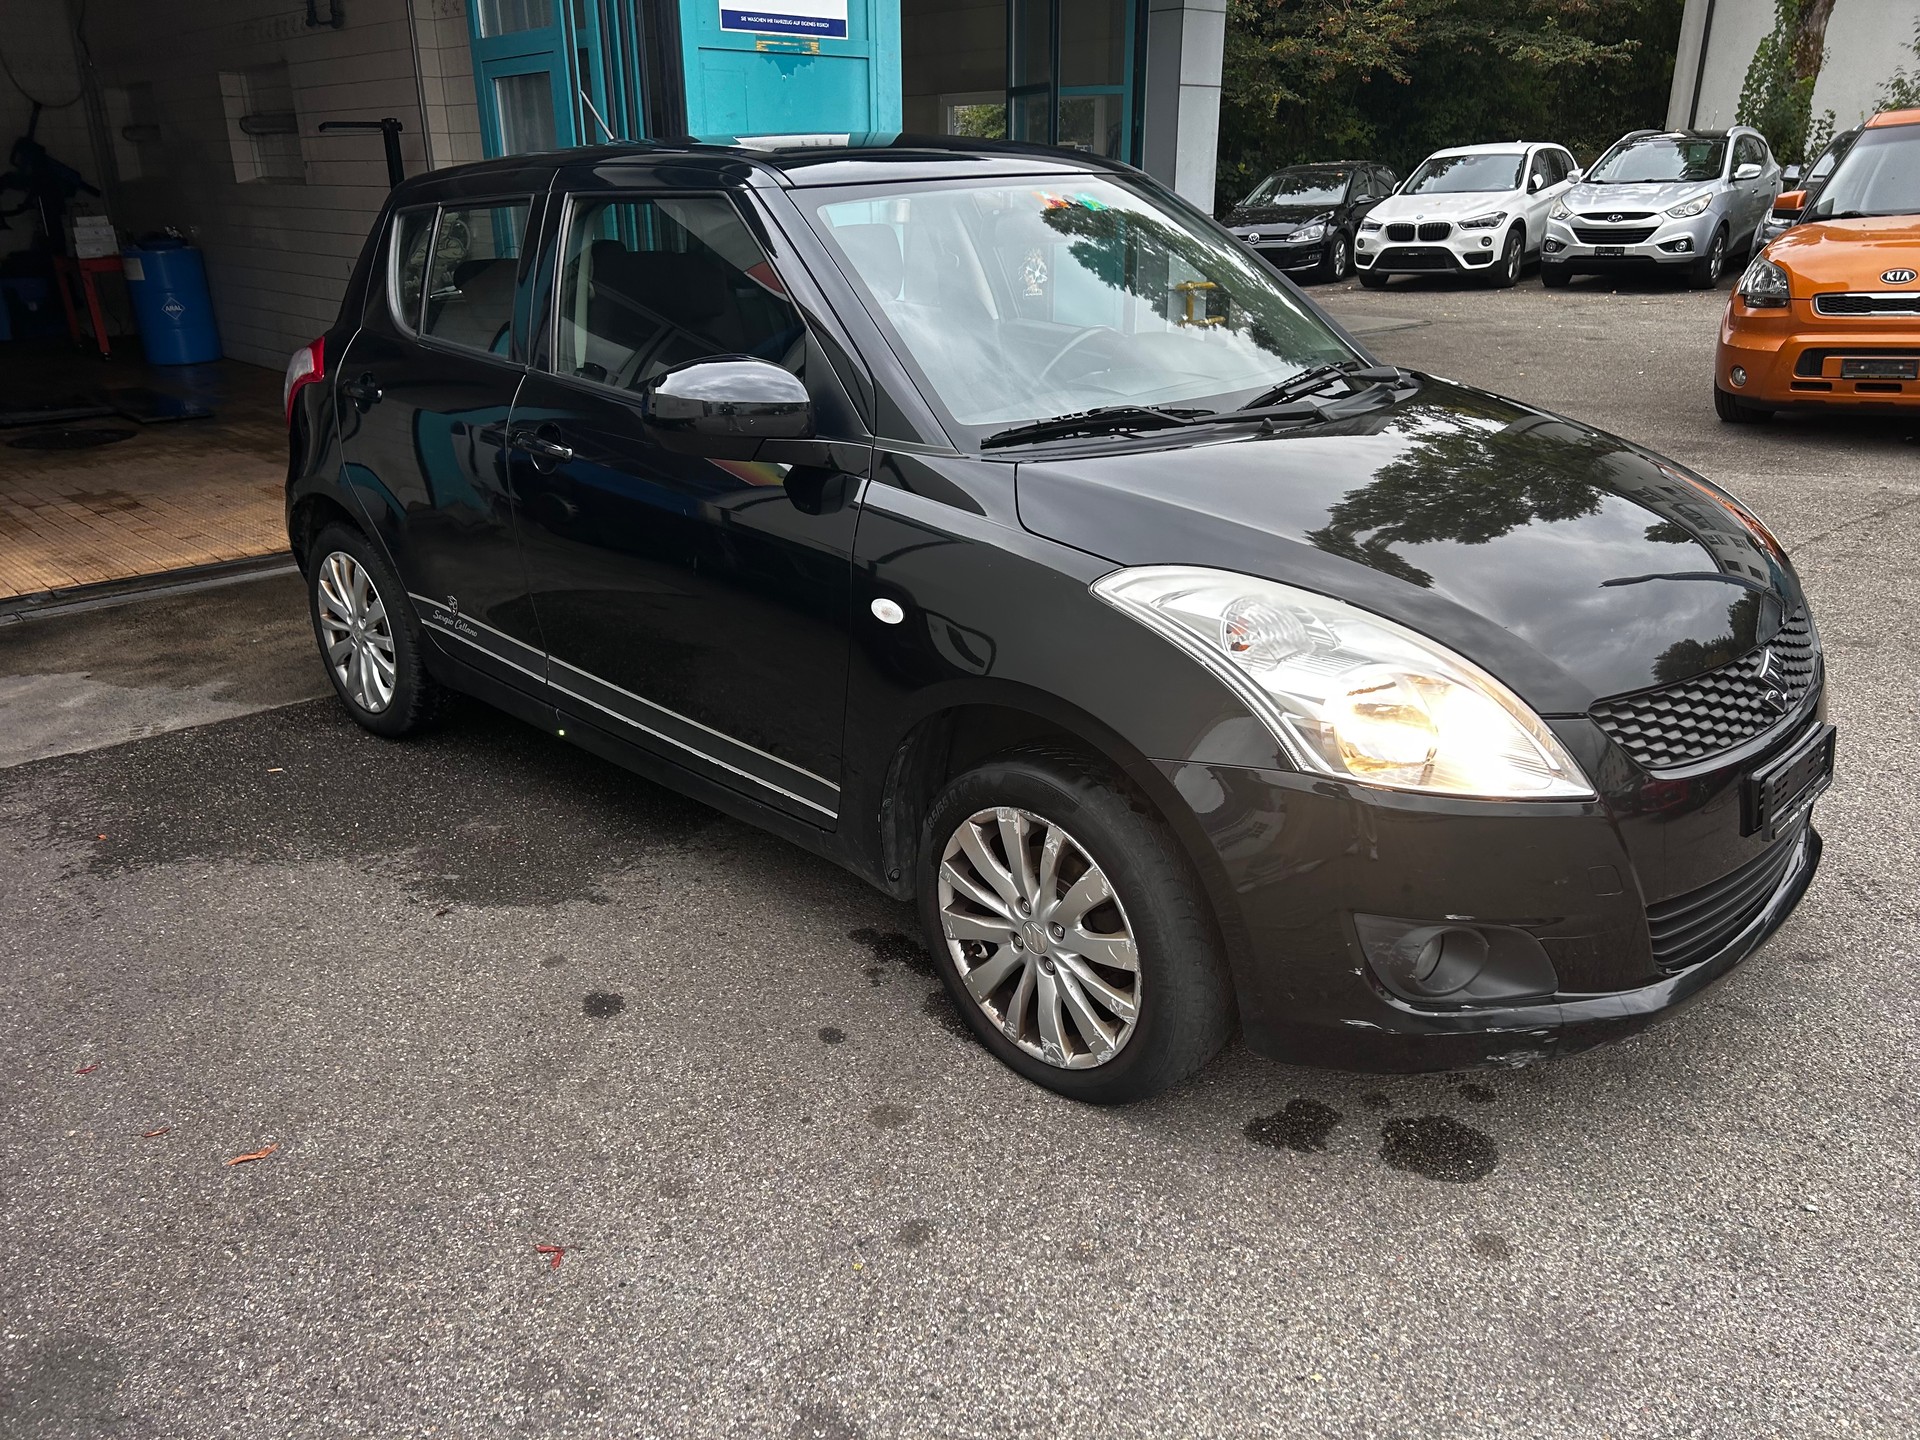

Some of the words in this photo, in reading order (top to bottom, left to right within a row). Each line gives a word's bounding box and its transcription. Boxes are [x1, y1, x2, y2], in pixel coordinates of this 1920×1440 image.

[1886, 271, 1910, 281] KIA
[165, 304, 182, 312] ARAL
[432, 609, 454, 626] Sergio
